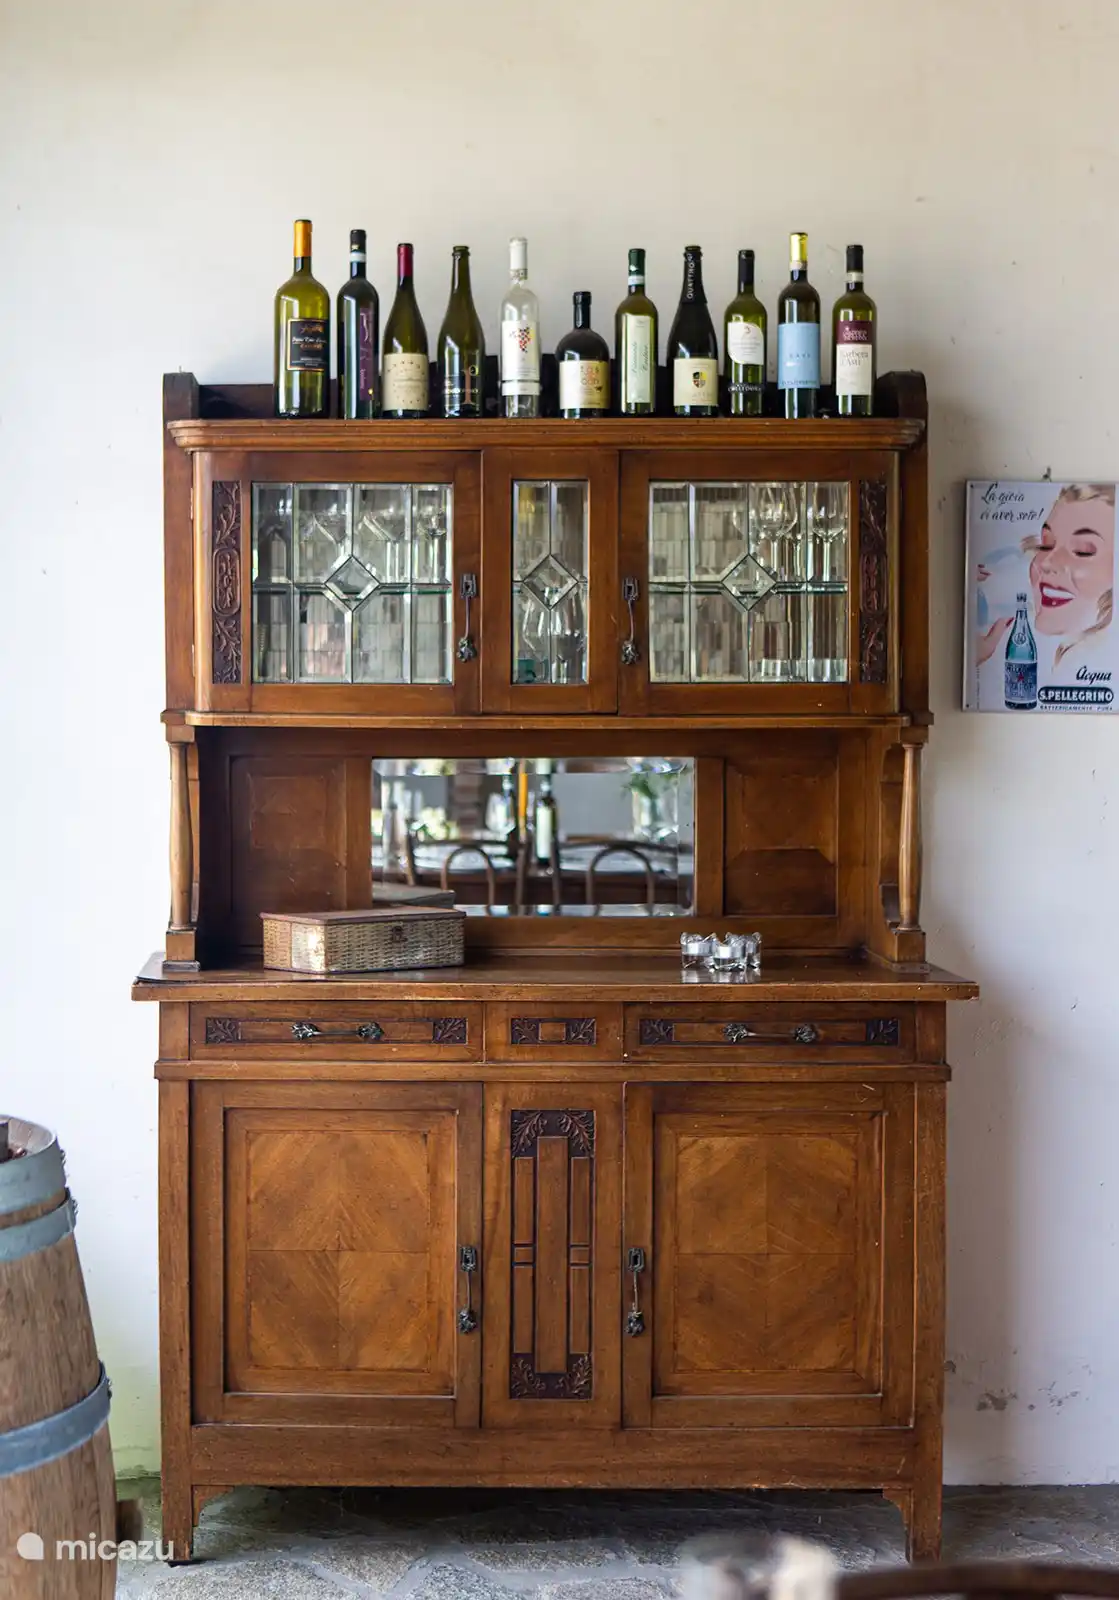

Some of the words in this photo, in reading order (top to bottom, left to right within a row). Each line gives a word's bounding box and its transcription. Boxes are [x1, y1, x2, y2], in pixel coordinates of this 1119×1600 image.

[981, 481, 998, 505] La
[1076, 665, 1112, 685] Acqua
[1039, 689, 1113, 702] S.PELLEGRINO
